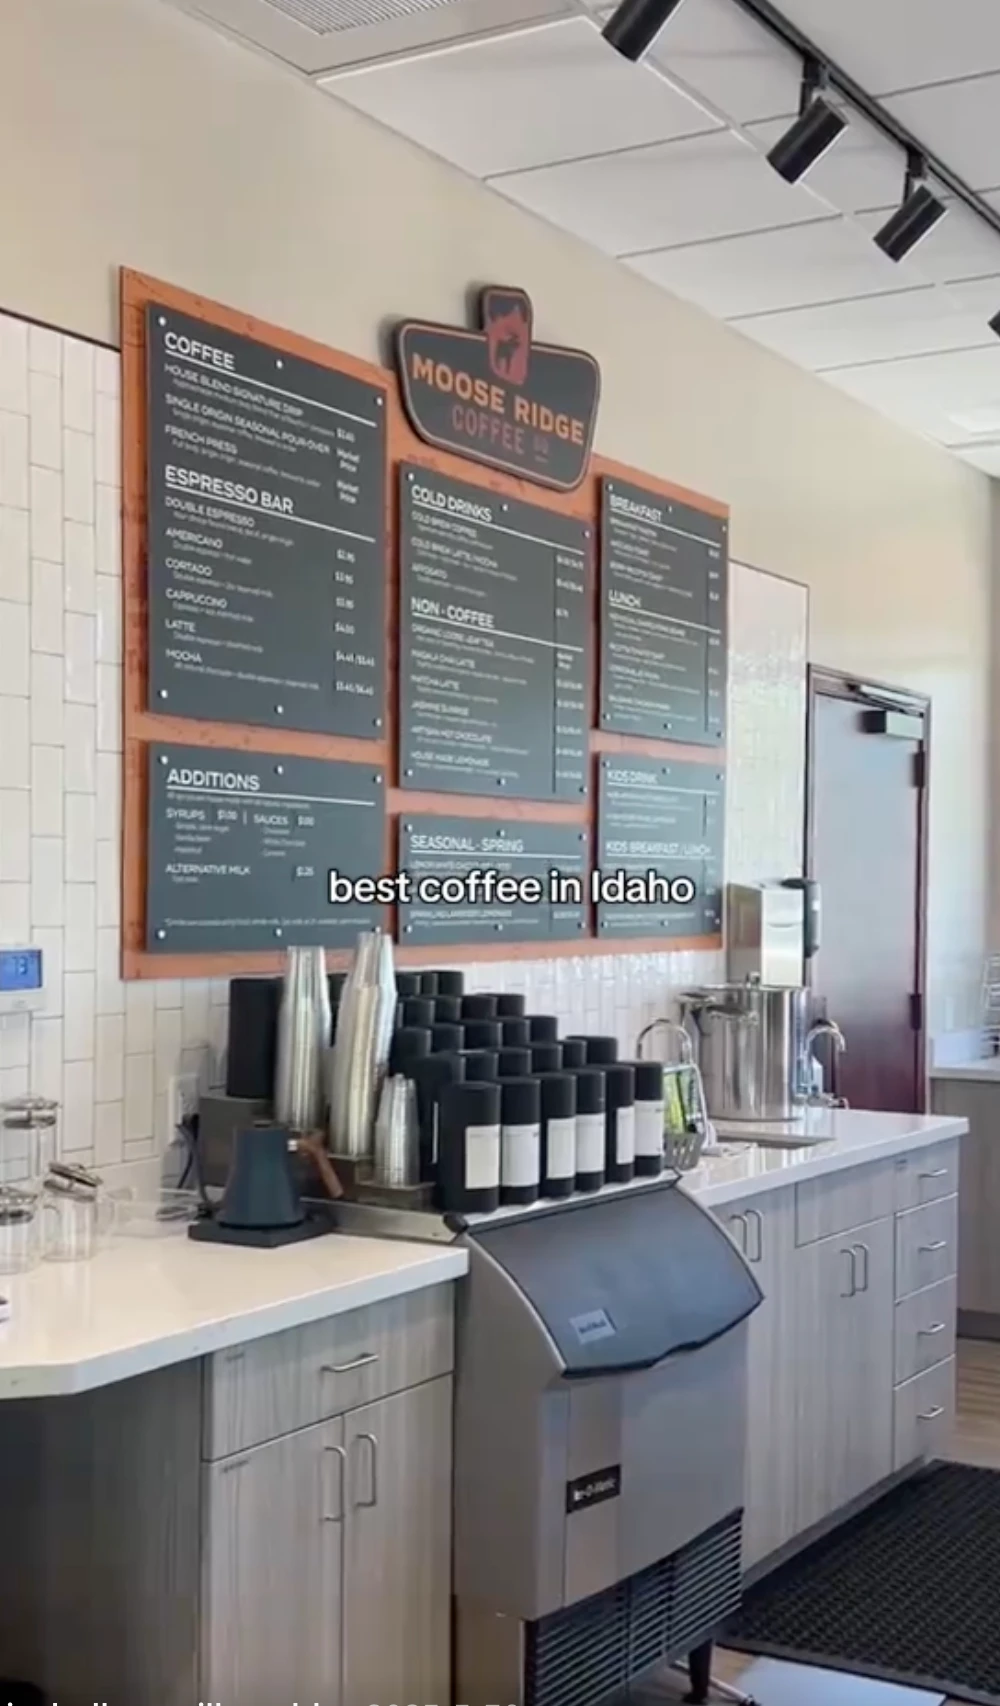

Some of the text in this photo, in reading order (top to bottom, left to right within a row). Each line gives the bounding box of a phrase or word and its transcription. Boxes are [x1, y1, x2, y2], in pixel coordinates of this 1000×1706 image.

[164, 331, 236, 371] COFFEE
[164, 363, 199, 384] HOUSE
[200, 374, 232, 394] BLEND
[233, 384, 281, 411] SIGNATURE
[412, 352, 585, 446] MOOSE RIDGE
[164, 392, 200, 413] SINGLE
[201, 404, 233, 424] ORIGIN
[235, 414, 281, 440] SEASONAL
[451, 403, 524, 454] COFFEE
[164, 424, 205, 444] FRENCH
[205, 436, 238, 455] PRESS
[165, 463, 258, 505] ESPRESSO
[260, 490, 294, 514] BAR
[411, 484, 493, 522] COLD DRINKS
[164, 495, 205, 516] DOUBLE
[206, 505, 255, 528] ESPRESSO
[609, 493, 662, 522] BREAKFAST
[165, 527, 223, 549] AMERICANO
[165, 557, 213, 577] CORTADO
[165, 587, 228, 610] CAPPUCCINO
[608, 587, 642, 608] LUNCH
[165, 617, 197, 633] LATTE
[411, 596, 440, 616] NON
[446, 604, 495, 629] COFFEE
[165, 648, 203, 664] MOCHA
[166, 768, 260, 791] ADDITIONS
[165, 806, 205, 821] SYRUPS
[253, 813, 289, 826] SAUCES
[410, 834, 475, 851] SEASONAL
[481, 838, 523, 854] SPRING
[165, 862, 252, 877] ALTERNATIVE MILK
